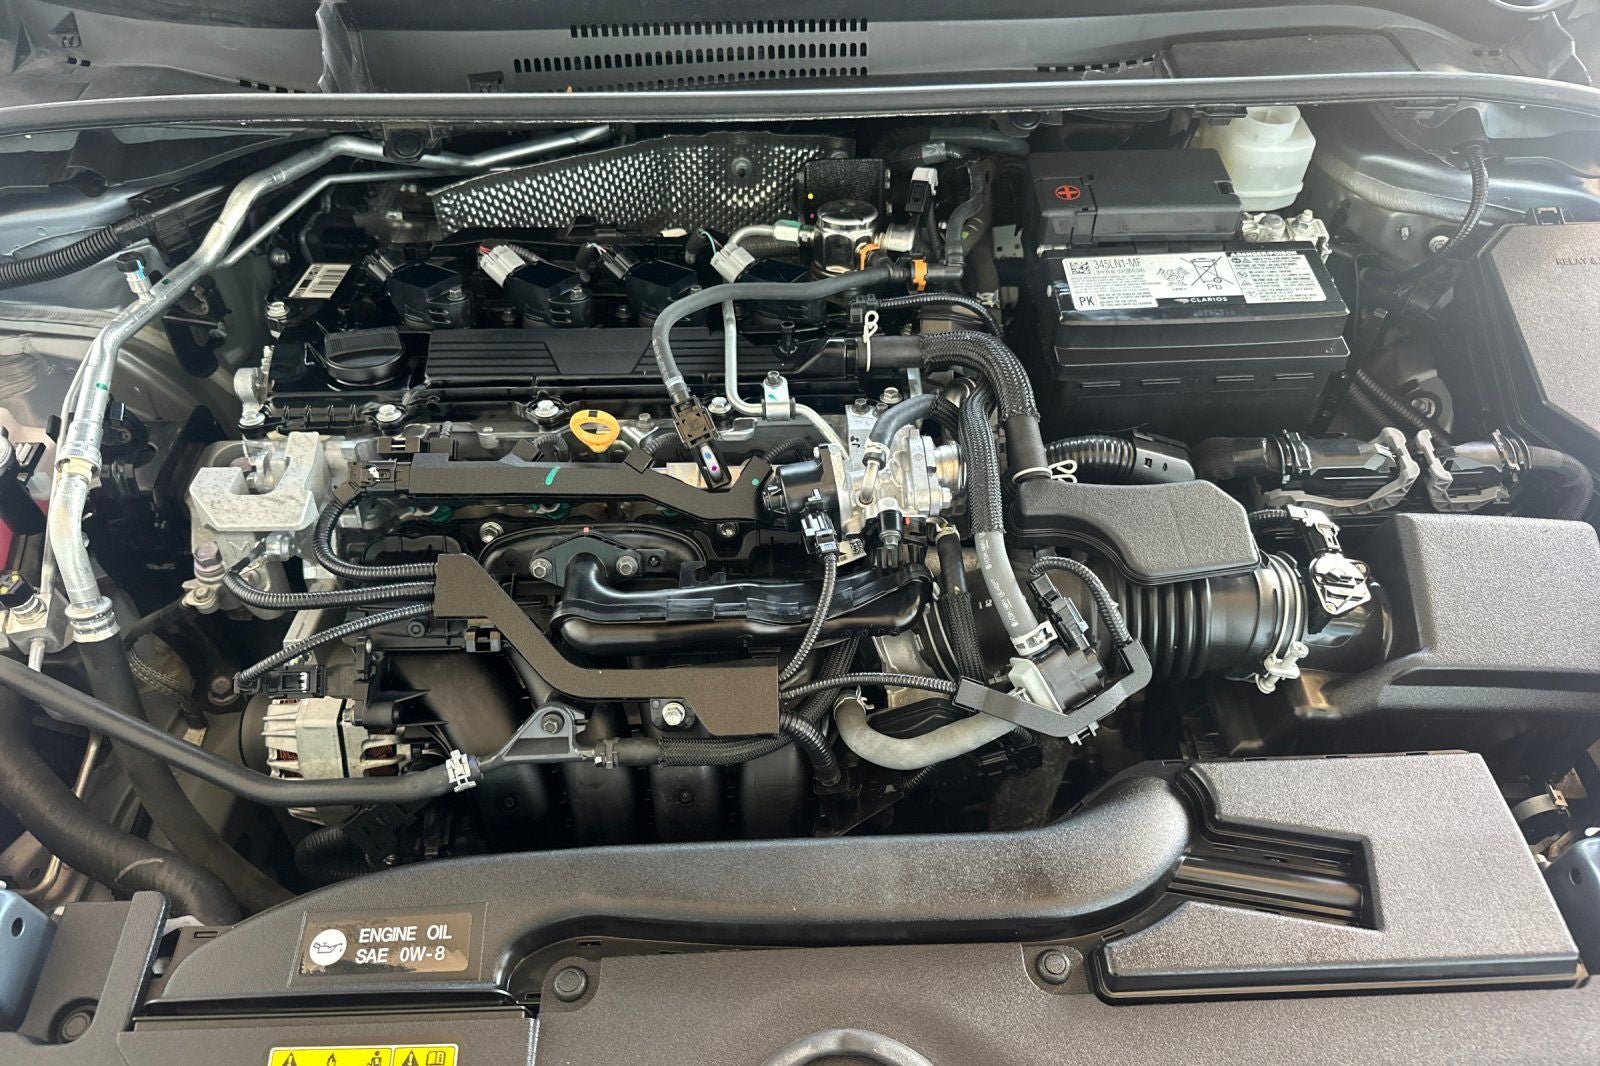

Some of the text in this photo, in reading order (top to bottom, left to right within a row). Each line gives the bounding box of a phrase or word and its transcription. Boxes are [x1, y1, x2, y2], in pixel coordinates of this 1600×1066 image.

[1093, 257, 1142, 269] 345LN1-MF
[1078, 296, 1096, 306] PK
[358, 924, 453, 943] ENGINE OIL
[355, 945, 446, 964] SAE 0W-8
